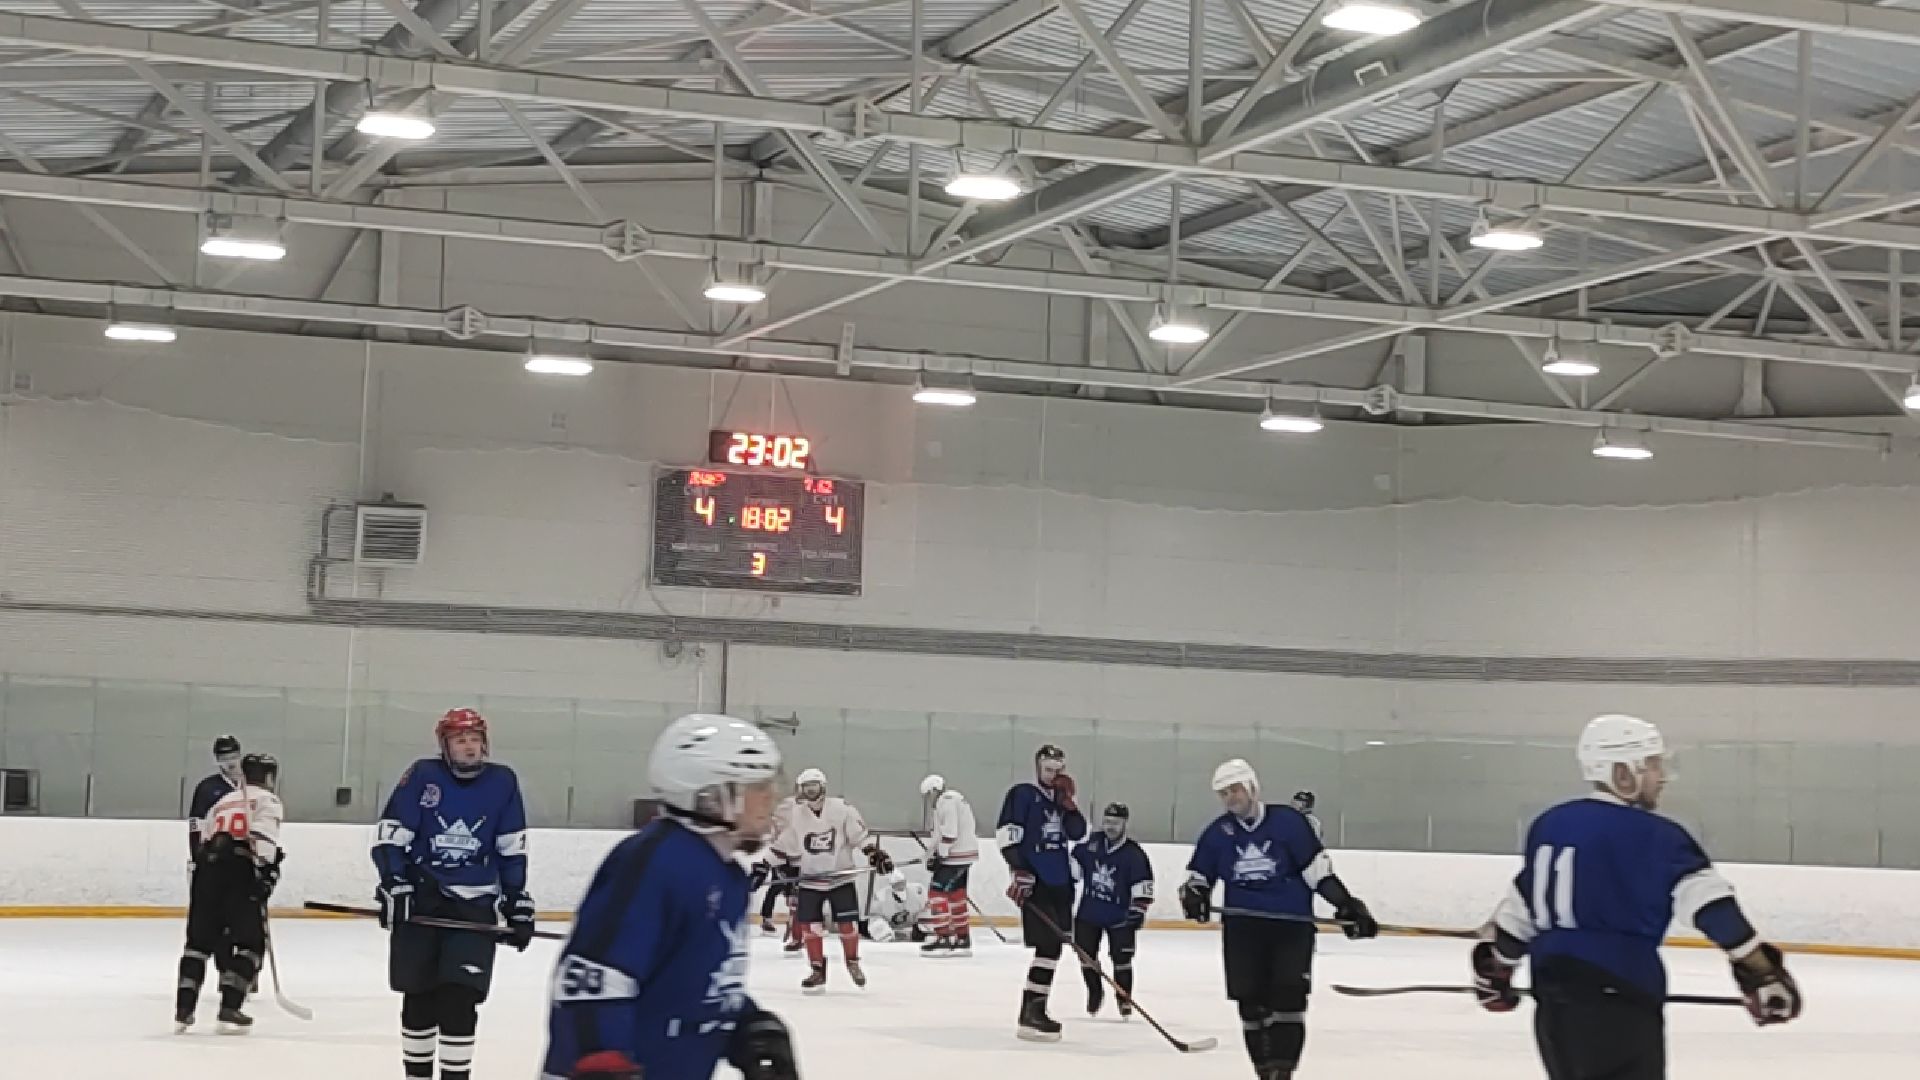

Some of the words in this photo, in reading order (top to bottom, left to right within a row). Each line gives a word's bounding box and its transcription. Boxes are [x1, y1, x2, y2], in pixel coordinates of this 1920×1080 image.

[728, 432, 809, 469] 23:02
[695, 496, 715, 526] 4
[825, 507, 845, 535] 4
[752, 552, 767, 576] 3
[378, 823, 400, 841] 17
[1532, 844, 1579, 930] 11
